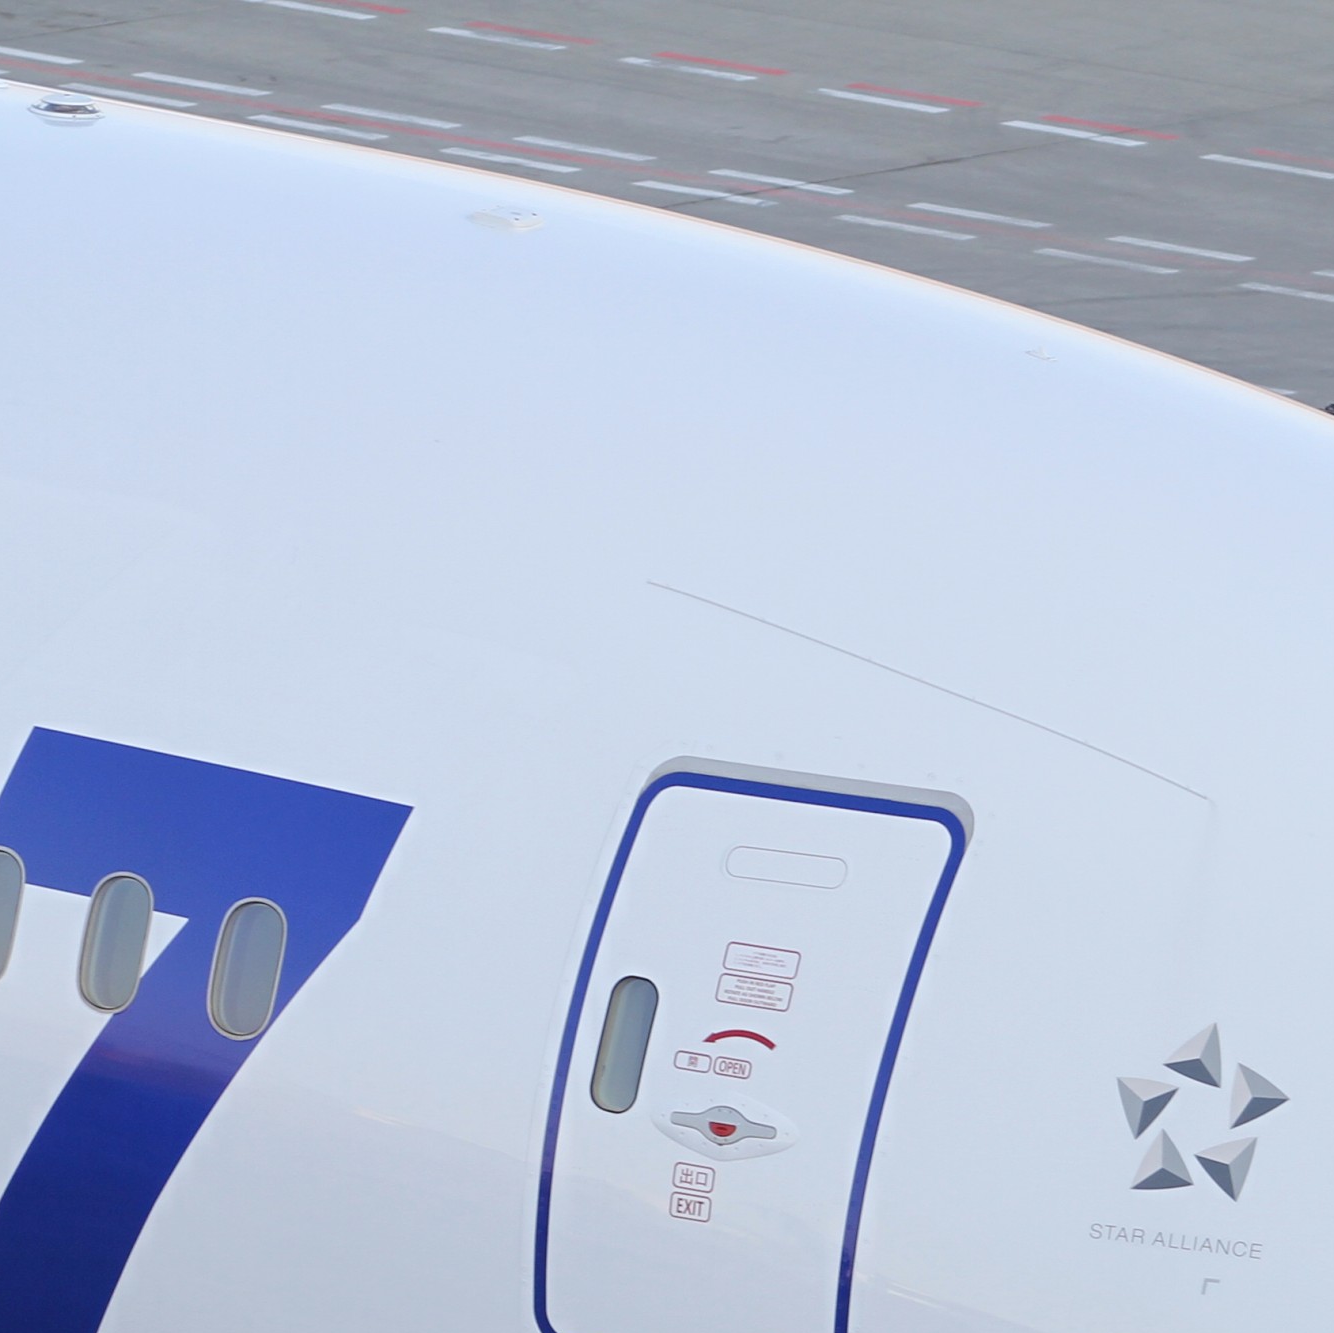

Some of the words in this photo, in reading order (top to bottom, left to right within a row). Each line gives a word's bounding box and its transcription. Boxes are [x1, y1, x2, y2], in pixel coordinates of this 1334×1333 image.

[718, 1060, 747, 1076] OPEN
[679, 1168, 708, 1186] 出口
[676, 1197, 705, 1217] EXIT
[1089, 1223, 1146, 1244] STAR
[1151, 1231, 1264, 1260] ALLIANCE
